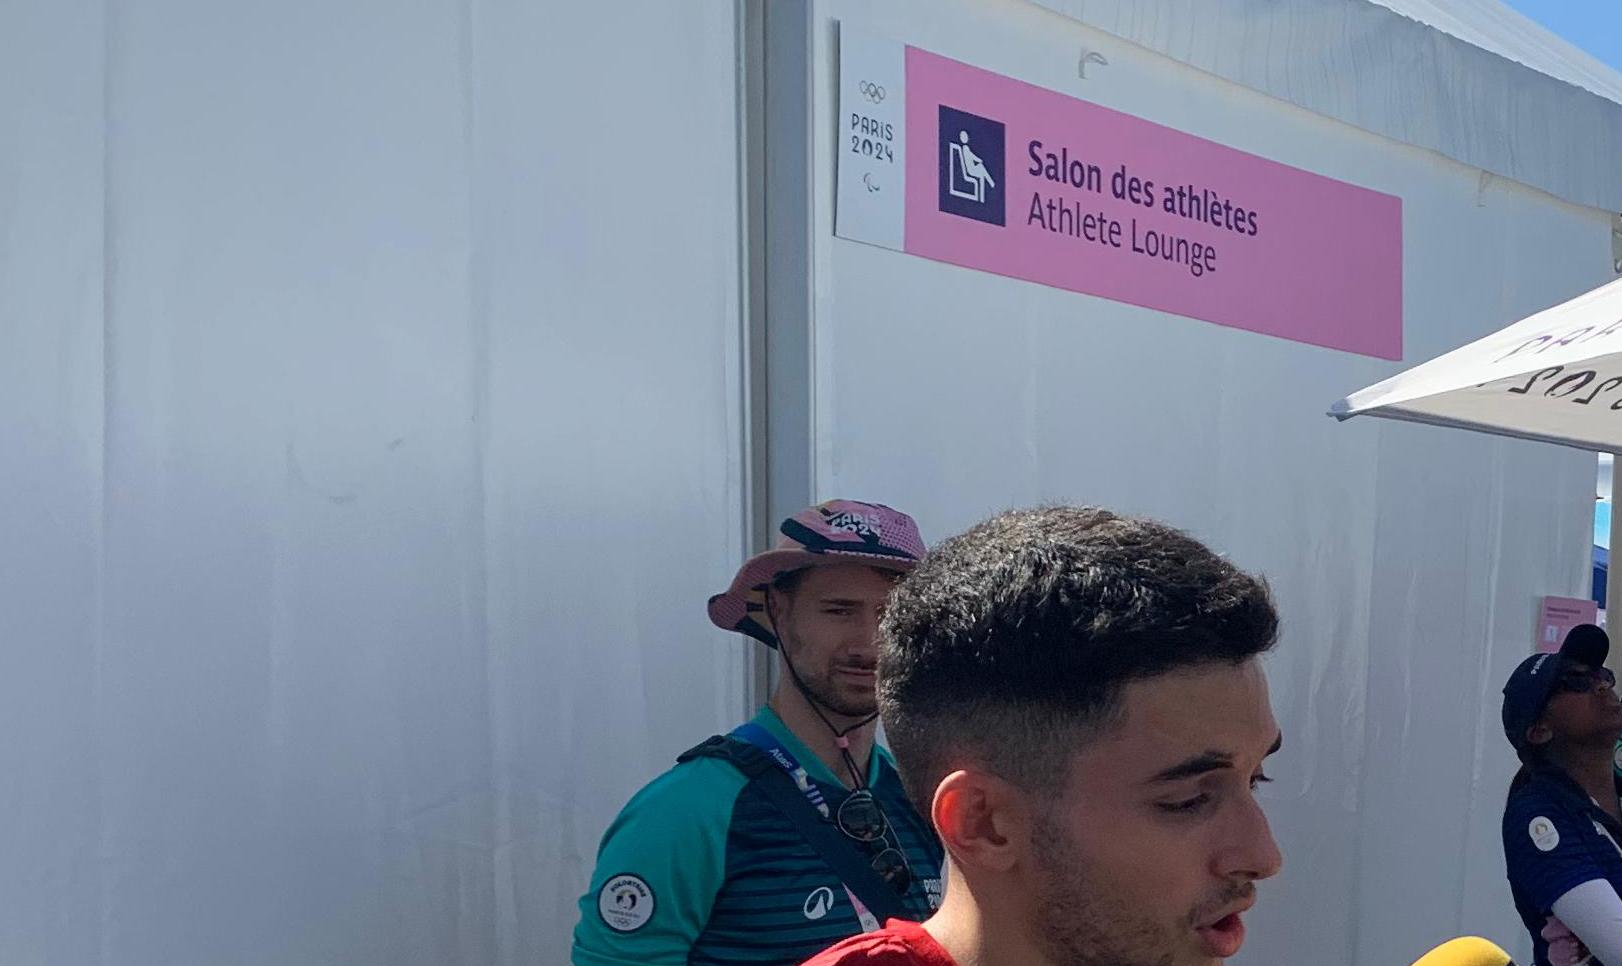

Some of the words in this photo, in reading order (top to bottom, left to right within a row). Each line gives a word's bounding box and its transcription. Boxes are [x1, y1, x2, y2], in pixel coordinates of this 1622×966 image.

[851, 135, 894, 164] 2024
[1028, 140, 1102, 194] Salon
[1111, 164, 1155, 208] des
[1163, 180, 1259, 237] athlètes
[1027, 191, 1123, 249] Athlete
[1131, 217, 1217, 277] Lounge
